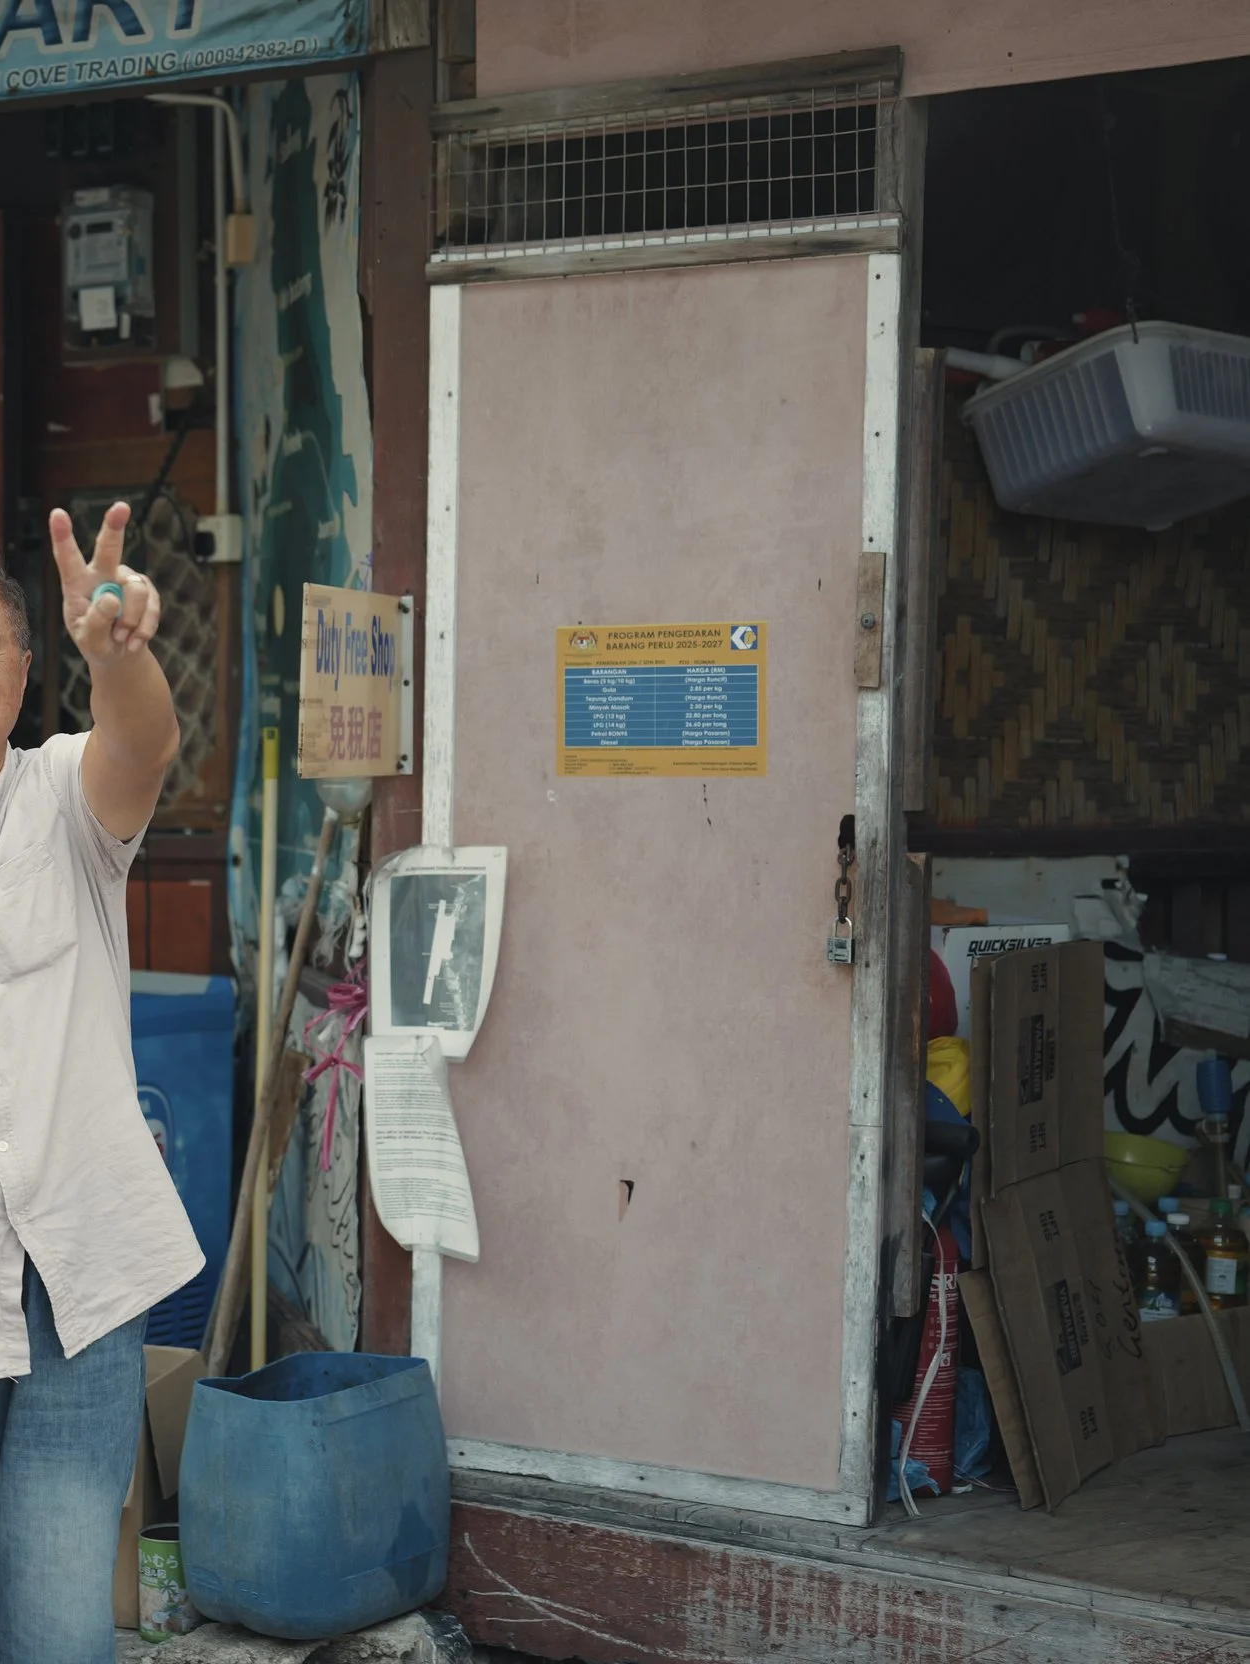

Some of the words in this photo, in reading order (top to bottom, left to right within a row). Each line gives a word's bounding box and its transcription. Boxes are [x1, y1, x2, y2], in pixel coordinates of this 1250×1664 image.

[6, 65, 67, 92] COVE
[75, 51, 178, 81] TRADING
[608, 631, 655, 640] PROGRAM
[657, 629, 721, 639] PENGEDARAN
[316, 608, 341, 692] Duty
[344, 612, 368, 676] Free
[371, 615, 395, 693] Shop
[606, 642, 645, 651] BARANG
[648, 641, 674, 650] PERLU
[676, 640, 723, 649] 2025-2027
[684, 676, 706, 684] (Harga
[684, 694, 706, 702] (Harga
